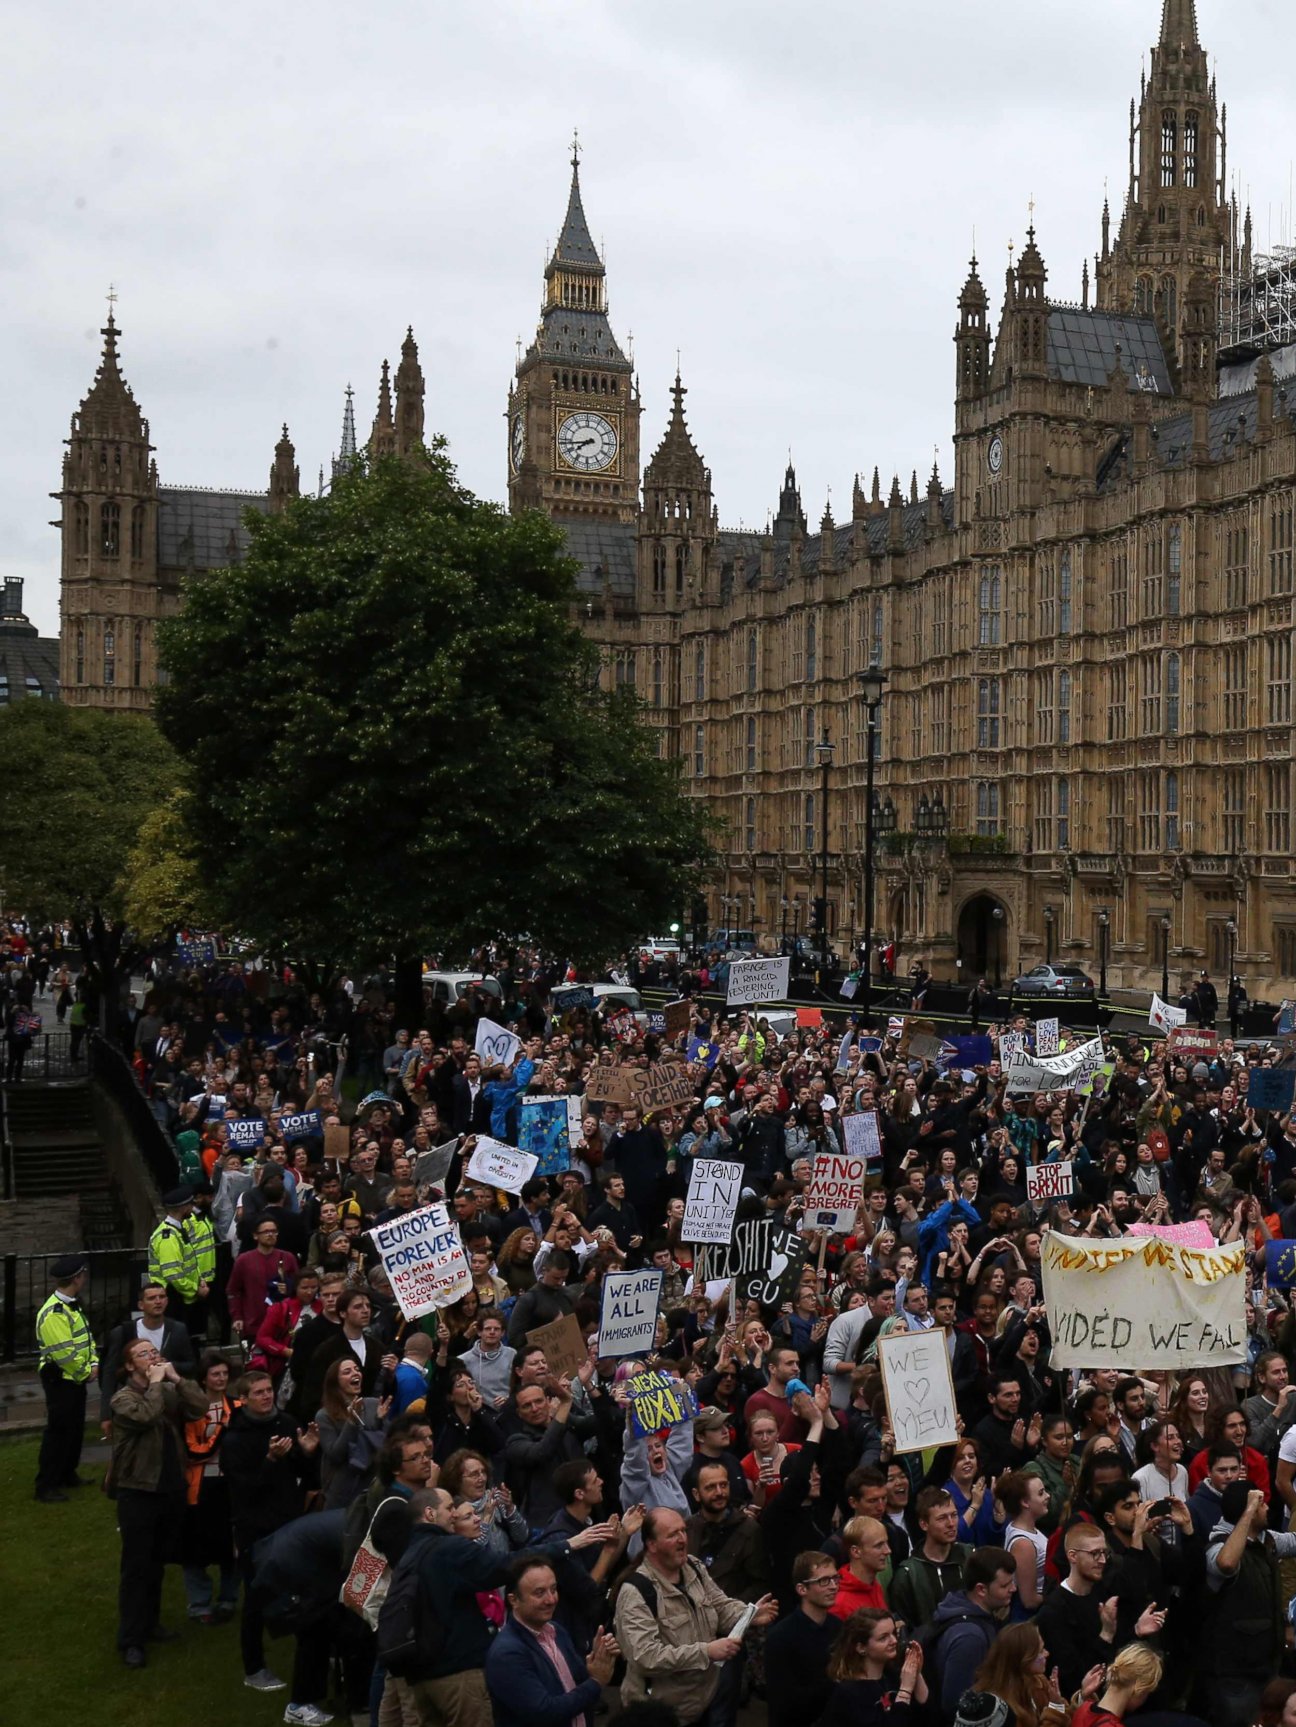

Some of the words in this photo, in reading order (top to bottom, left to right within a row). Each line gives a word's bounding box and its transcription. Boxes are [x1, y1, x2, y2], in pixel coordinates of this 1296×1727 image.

[732, 962, 768, 974] FARAGE
[773, 960, 782, 968] IS
[743, 973, 777, 982] RANCID
[729, 982, 774, 997] FESTERING
[745, 988, 780, 1001] CUNT!
[634, 1064, 676, 1091] STAND
[1011, 1075, 1031, 1086] FOR
[228, 1121, 264, 1132] VOTE
[281, 1113, 318, 1128] VOTE
[694, 1160, 742, 1182] STAND
[813, 1156, 864, 1180] #NO
[1036, 1163, 1063, 1180] STOP
[690, 1181, 733, 1206] IN
[809, 1181, 862, 1199] MORE
[1028, 1175, 1072, 1200] BREXIT
[686, 1205, 726, 1219] UNITY
[377, 1208, 447, 1250] EUROPE
[384, 1231, 458, 1273] FOREVER
[393, 1271, 411, 1285] NO
[411, 1261, 435, 1276] MAN
[437, 1255, 448, 1266] IS
[401, 1292, 416, 1304] NO
[415, 1276, 455, 1296] COUNTRY
[610, 1284, 631, 1299] WE
[633, 1277, 660, 1296] ARE
[404, 1294, 432, 1310] ITSELF
[610, 1299, 645, 1320] ALL
[601, 1321, 654, 1343] IMMIGRANTS
[1149, 1321, 1192, 1351] WE
[888, 1347, 929, 1374] WE
